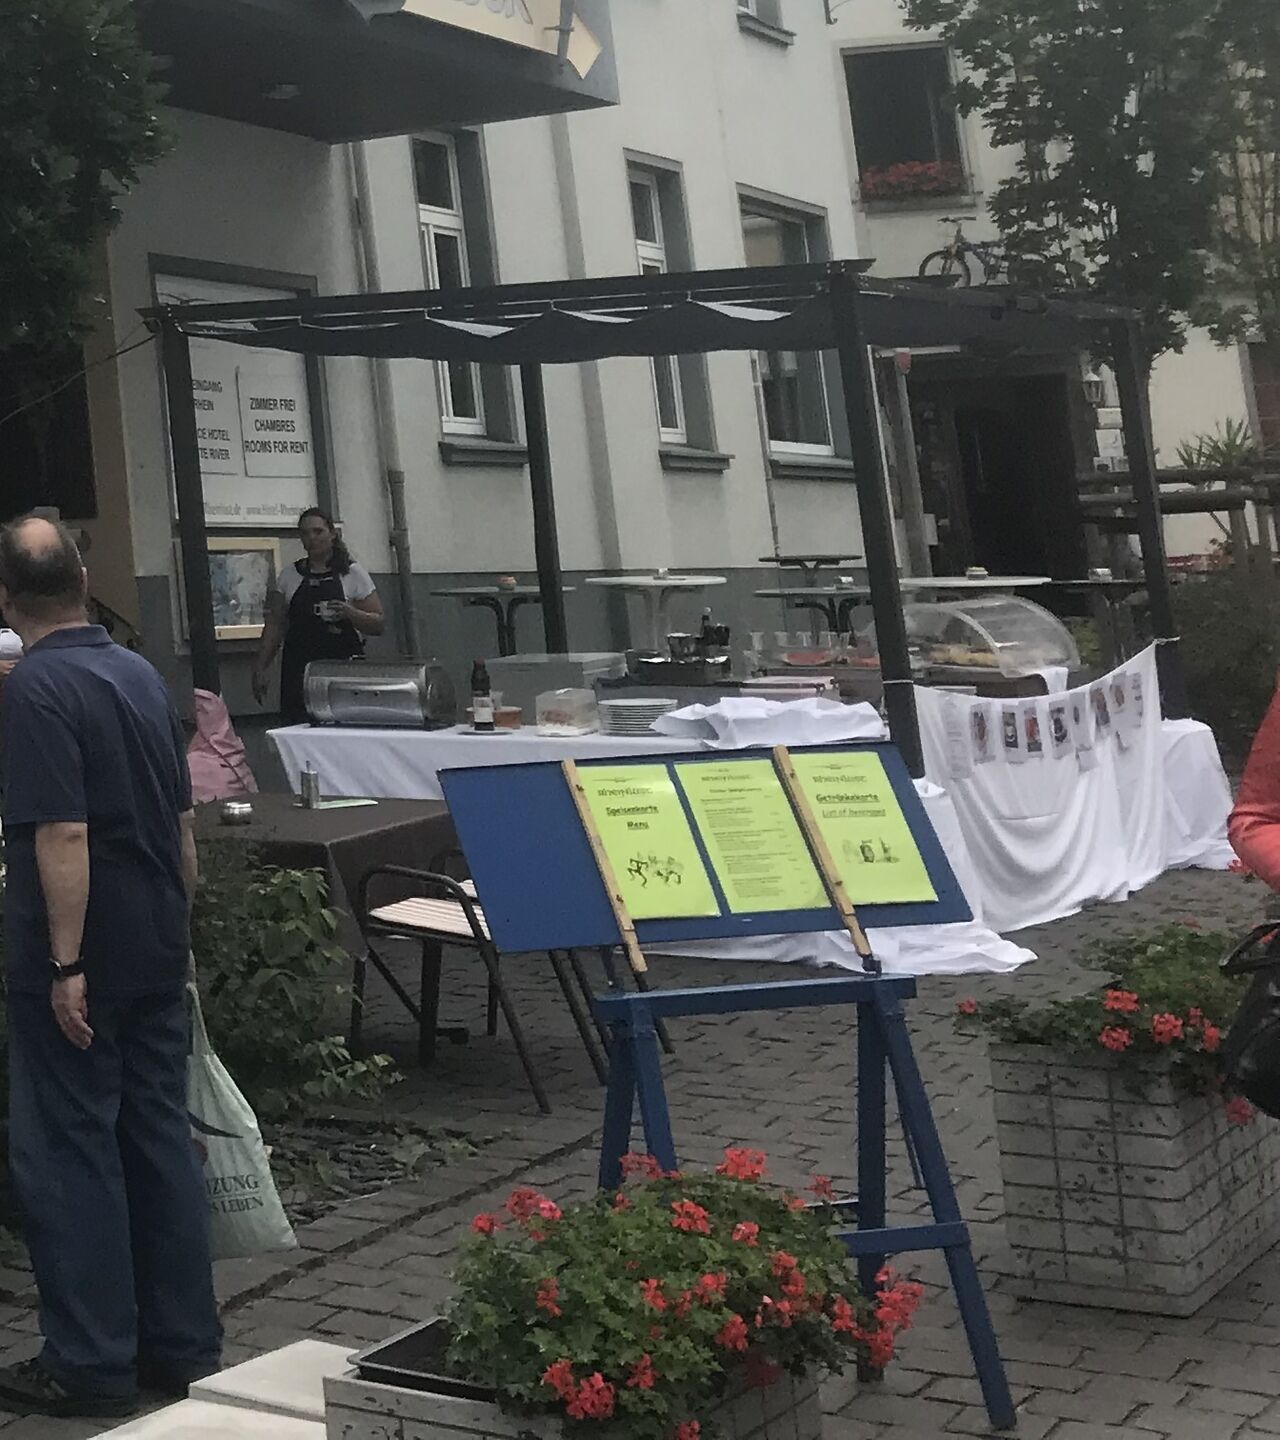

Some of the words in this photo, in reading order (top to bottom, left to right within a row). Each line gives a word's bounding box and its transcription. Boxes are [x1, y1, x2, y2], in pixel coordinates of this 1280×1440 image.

[249, 397, 278, 410] ZIMMER
[279, 398, 296, 411] FREI
[254, 419, 296, 433] CHAMBRES
[207, 428, 231, 442] HOTEL
[244, 440, 272, 453] ROOMS
[273, 440, 288, 453] FOR
[289, 440, 309, 454] RENT
[221, 1197, 264, 1213] LEBEN
